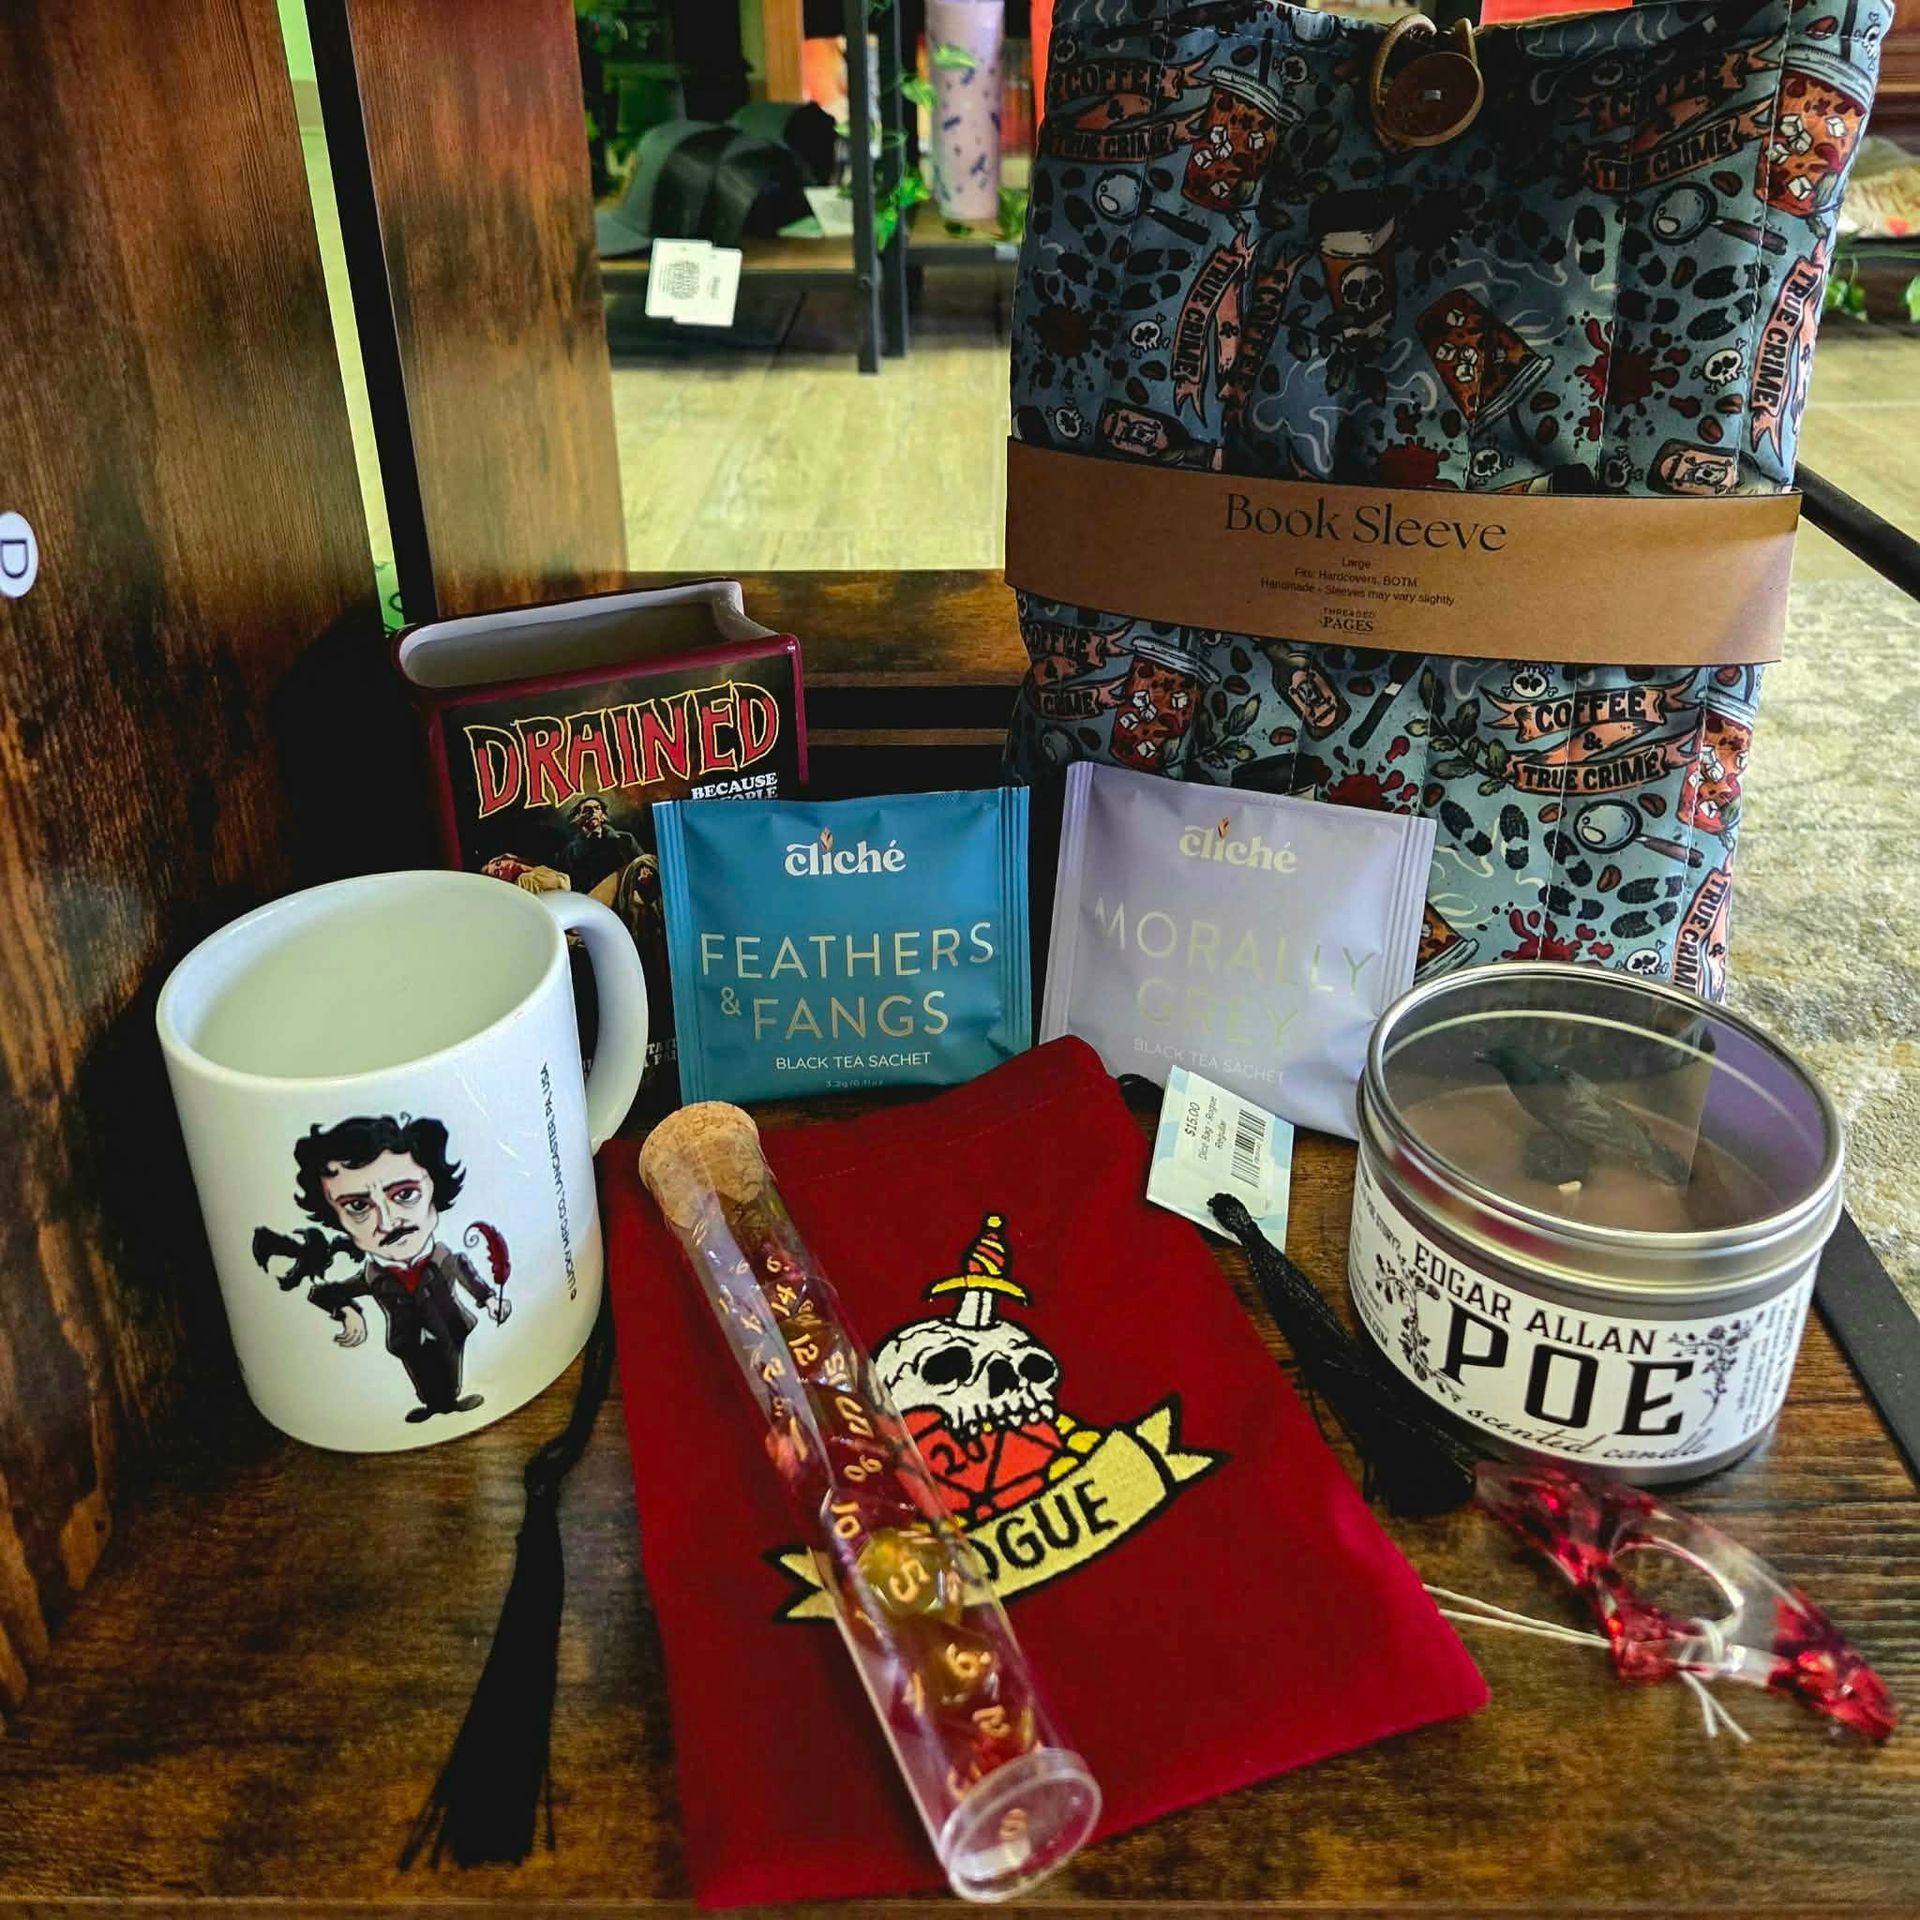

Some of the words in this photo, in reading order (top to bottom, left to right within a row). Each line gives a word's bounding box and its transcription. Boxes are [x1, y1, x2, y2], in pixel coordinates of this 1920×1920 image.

[1650, 122, 1735, 178] CRIME
[1191, 255, 1235, 308] TRUE
[1776, 268, 1820, 328] TRUE
[1174, 307, 1205, 378] CRIME
[1753, 327, 1789, 409] CRIME
[1224, 493, 1341, 541] Book
[1352, 502, 1507, 552] Sleeve
[1341, 557, 1372, 569] Large
[1382, 575, 1418, 588] BOTM
[1260, 577, 1315, 592] Handmade
[1324, 584, 1366, 599] Sleeves
[1367, 590, 1391, 602] may
[1392, 593, 1417, 604] vary
[1418, 594, 1455, 607] slightly
[1322, 616, 1374, 632] PAGES
[1535, 690, 1647, 733] COFFEE
[463, 680, 779, 820] DRAINED
[1582, 731, 1603, 751] &
[690, 772, 779, 800] BECAUSE
[1523, 765, 1579, 790] TRUE
[1582, 750, 1662, 790] CRIME
[784, 838, 907, 877] cliché
[1178, 825, 1298, 874] cliché
[1690, 879, 1728, 930] TRUE
[700, 921, 996, 980] FEATHERS
[1095, 897, 1376, 995] MORALLY
[720, 986, 742, 1017] &
[752, 990, 951, 1041] FANGS
[1136, 976, 1299, 1049] GREY
[775, 1055, 830, 1071] BLACK
[832, 1054, 865, 1069] TEA
[867, 1051, 932, 1068] SACHET
[1133, 1037, 1188, 1061] BLACK
[1190, 1050, 1218, 1069] TEA
[1221, 1060, 1285, 1085] SACHET
[1184, 1101, 1201, 1137] $15.00
[1413, 1240, 1513, 1324] EDGAR
[1523, 1309, 1658, 1356] ALLAN
[1440, 1300, 1695, 1437] POE
[929, 1436, 988, 1476] 20
[1466, 1403, 1607, 1456] scented
[1602, 1427, 1716, 1461] candle
[960, 1478, 1119, 1586] OGUE
